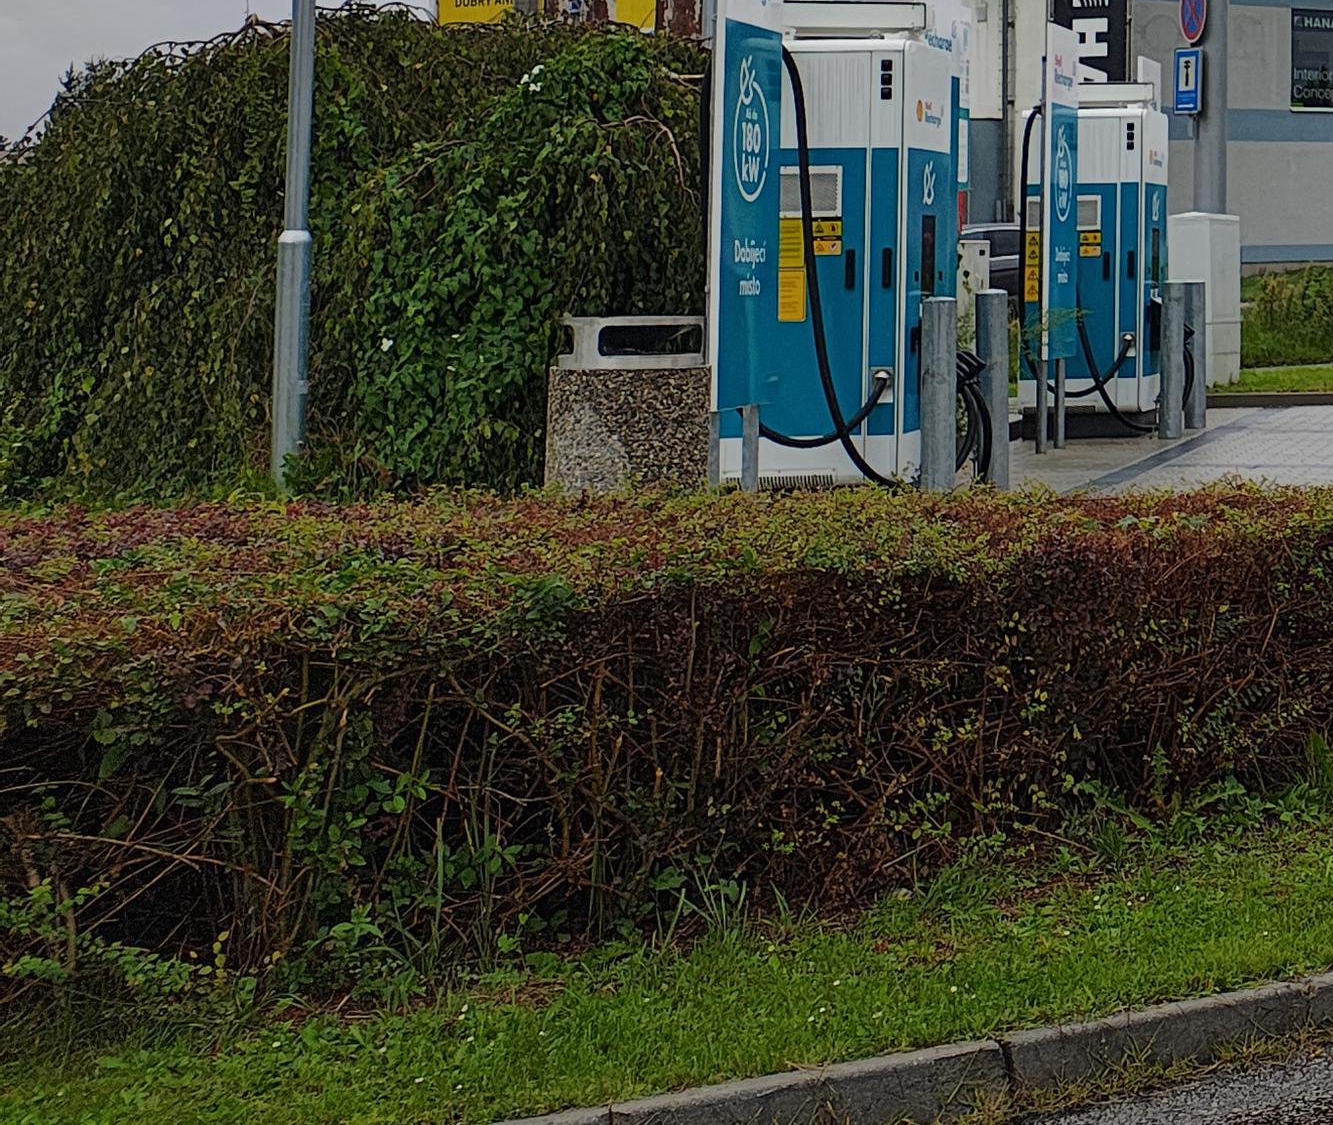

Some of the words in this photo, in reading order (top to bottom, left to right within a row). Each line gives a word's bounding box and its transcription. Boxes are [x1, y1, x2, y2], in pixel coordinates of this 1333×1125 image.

[1294, 67, 1333, 81] Interior
[741, 121, 761, 154] 180
[741, 156, 760, 183] kW
